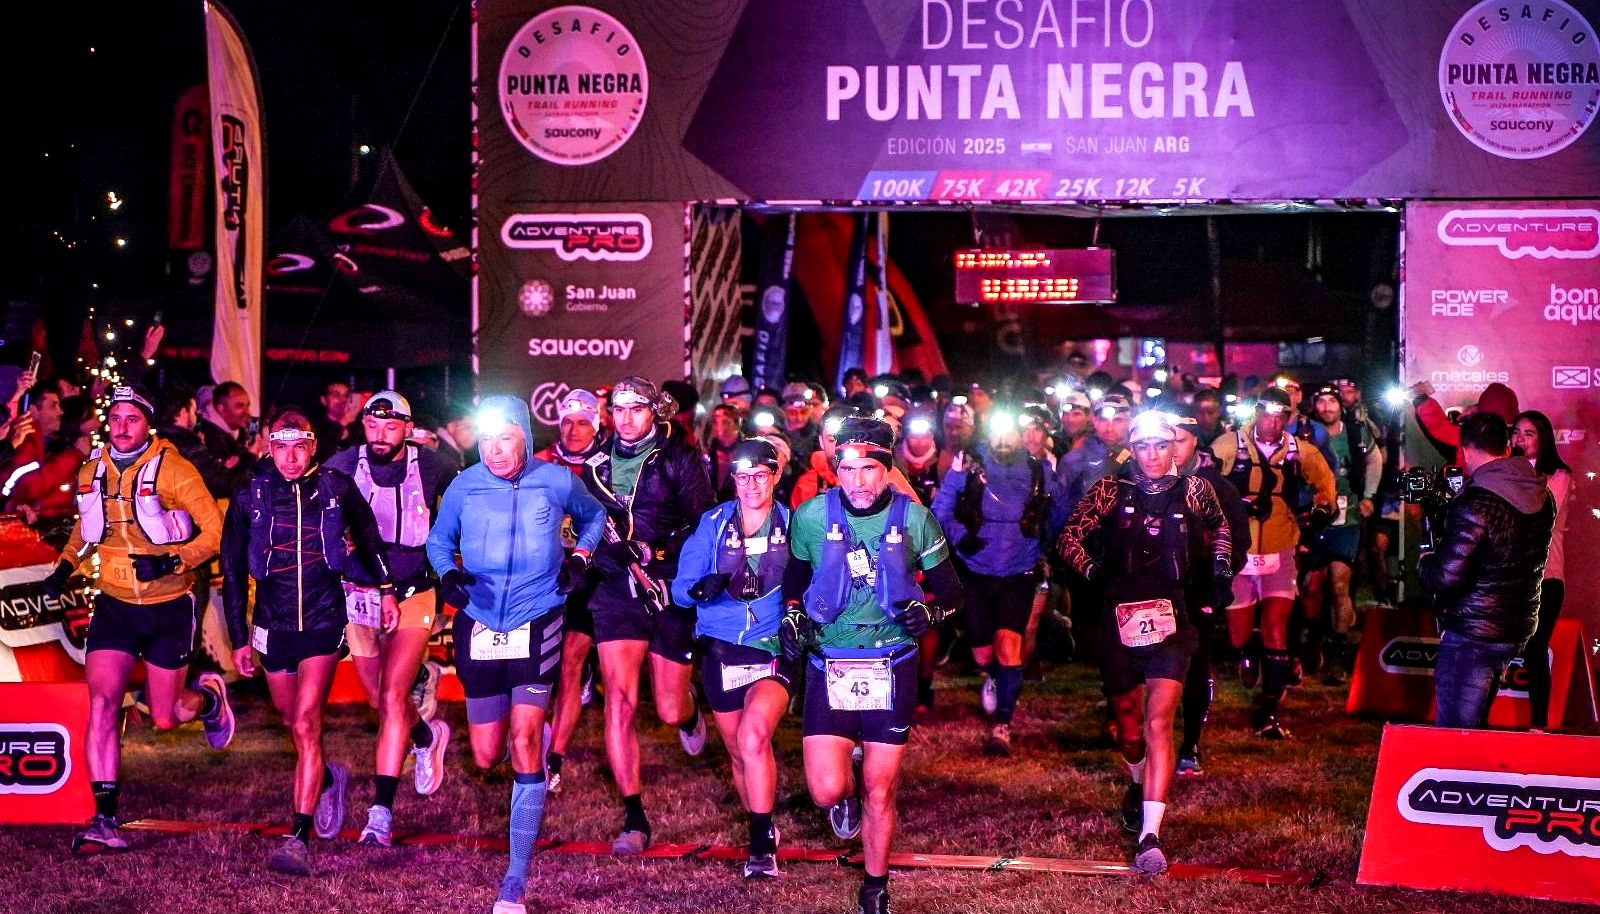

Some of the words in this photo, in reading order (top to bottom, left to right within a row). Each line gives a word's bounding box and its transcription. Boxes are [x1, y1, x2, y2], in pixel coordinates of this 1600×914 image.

[922, 0, 1154, 49] DESAFIO
[1460, 5, 1586, 46] DESAFIO
[518, 19, 630, 58] DESAFIO
[1448, 64, 1519, 85] PUNTA
[1527, 63, 1600, 84] NEGRA
[507, 75, 570, 95] PUNTA
[578, 73, 643, 93] NEGRA
[826, 64, 1021, 121] PUNTA
[1046, 61, 1255, 119] NEGRA
[1471, 91, 1507, 100] TRAIL
[1512, 91, 1573, 100] RUNNING
[528, 101, 559, 110] TRAIL
[563, 99, 618, 109] RUNNING
[544, 127, 601, 139] saucony
[1490, 120, 1554, 132] saucony
[887, 135, 956, 154] EDICIÓN
[963, 138, 1007, 155] 2025
[1065, 137, 1098, 154] SAN
[1104, 137, 1147, 154] JUAN
[1153, 136, 1191, 153] ARG
[872, 179, 926, 197] 100K
[940, 179, 985, 197] 75K
[996, 179, 1042, 197] 42K
[1055, 179, 1103, 197] 25K
[1114, 178, 1154, 196] 12K
[1172, 178, 1207, 196] 5K
[513, 226, 640, 236] ADVENTURE
[1452, 223, 1593, 232] ADVENTURE
[567, 235, 641, 249] PRO
[566, 285, 595, 299] San
[598, 285, 637, 300] Juan
[1431, 290, 1509, 304] POWER
[1550, 284, 1600, 304] bon
[566, 302, 608, 312] Gobierno
[1431, 303, 1475, 317] ADE
[528, 338, 634, 360] saucony
[1431, 370, 1510, 383] metales
[114, 567, 128, 580] 81
[354, 601, 368, 615] 41
[1139, 618, 1157, 635] 21
[492, 633, 509, 647] 53
[850, 681, 870, 697] 43
